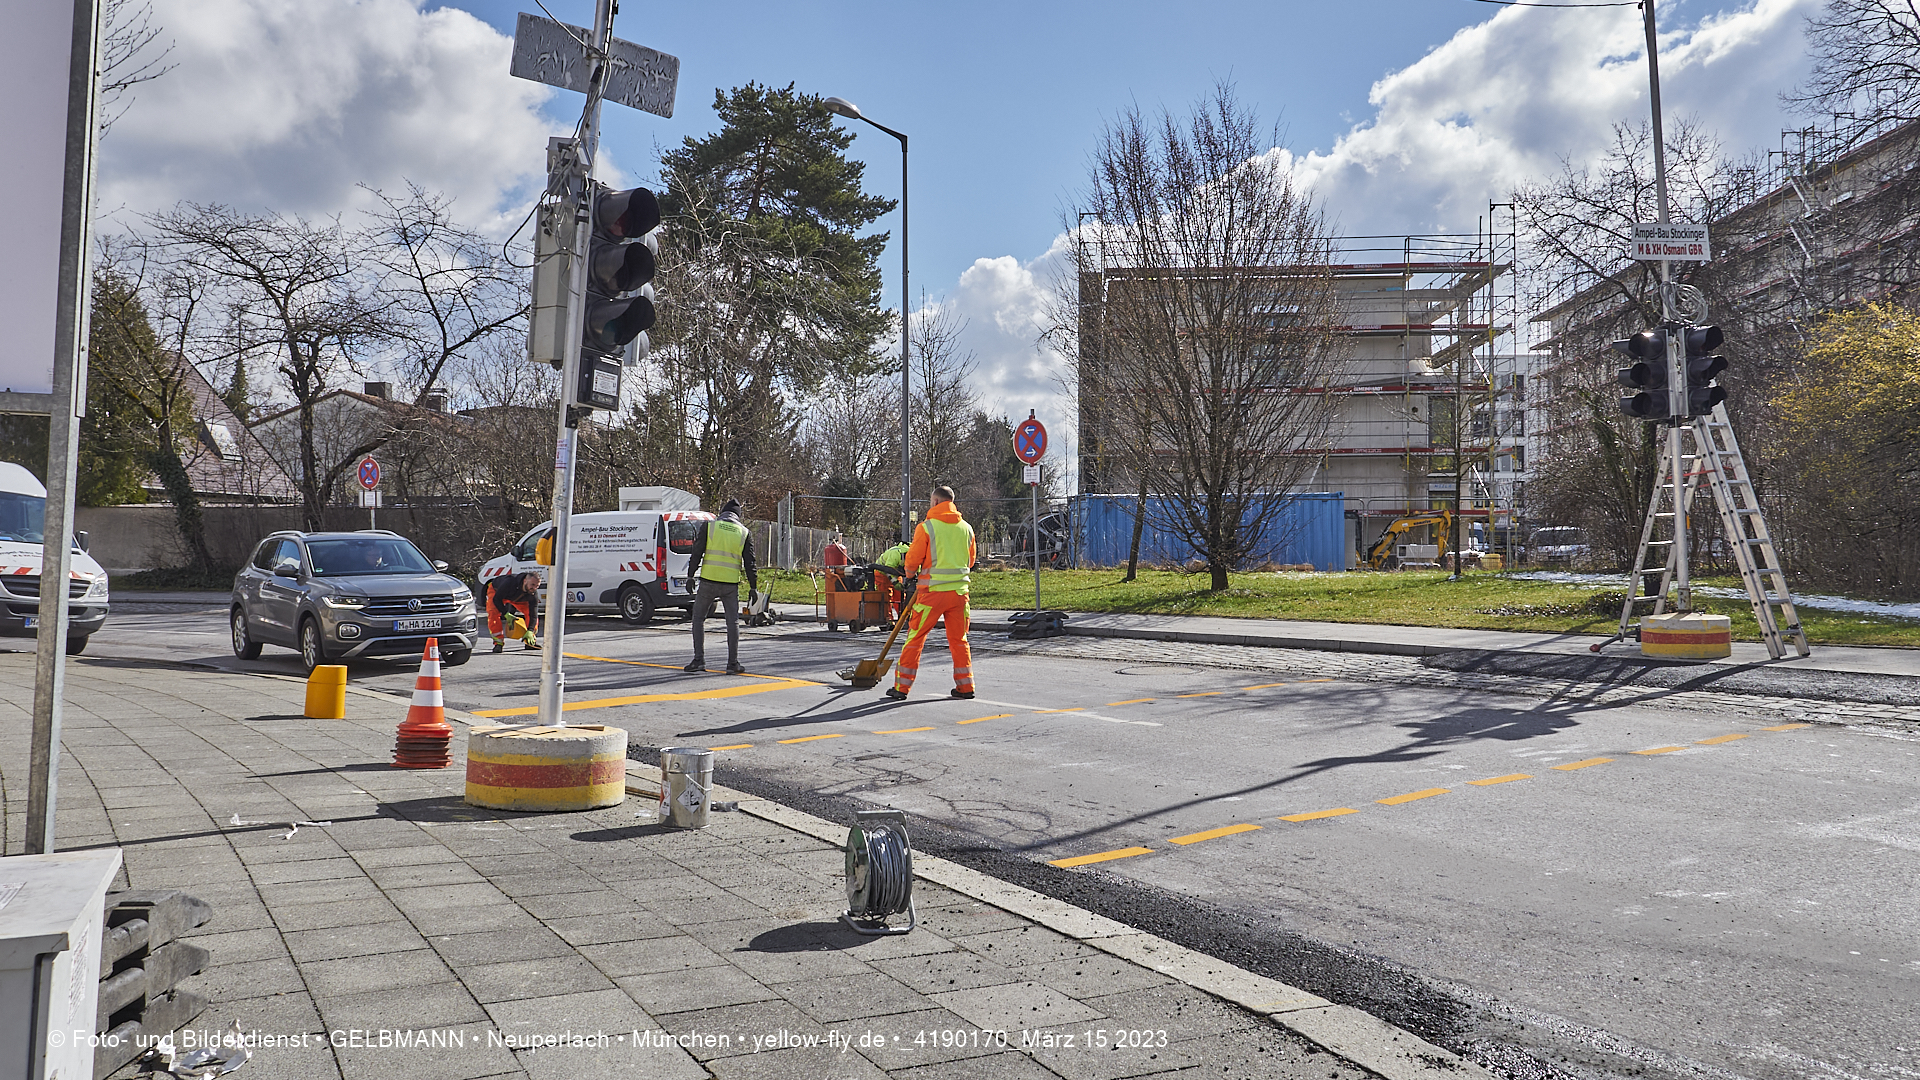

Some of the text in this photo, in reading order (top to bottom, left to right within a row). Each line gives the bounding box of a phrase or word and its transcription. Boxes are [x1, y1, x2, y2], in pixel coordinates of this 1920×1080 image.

[1634, 227, 1705, 241] Ampel-Bau Stockinger
[1638, 243, 1704, 255] M & XH Osmani GBR
[609, 524, 639, 533] Stockinger
[421, 619, 440, 627] 1214
